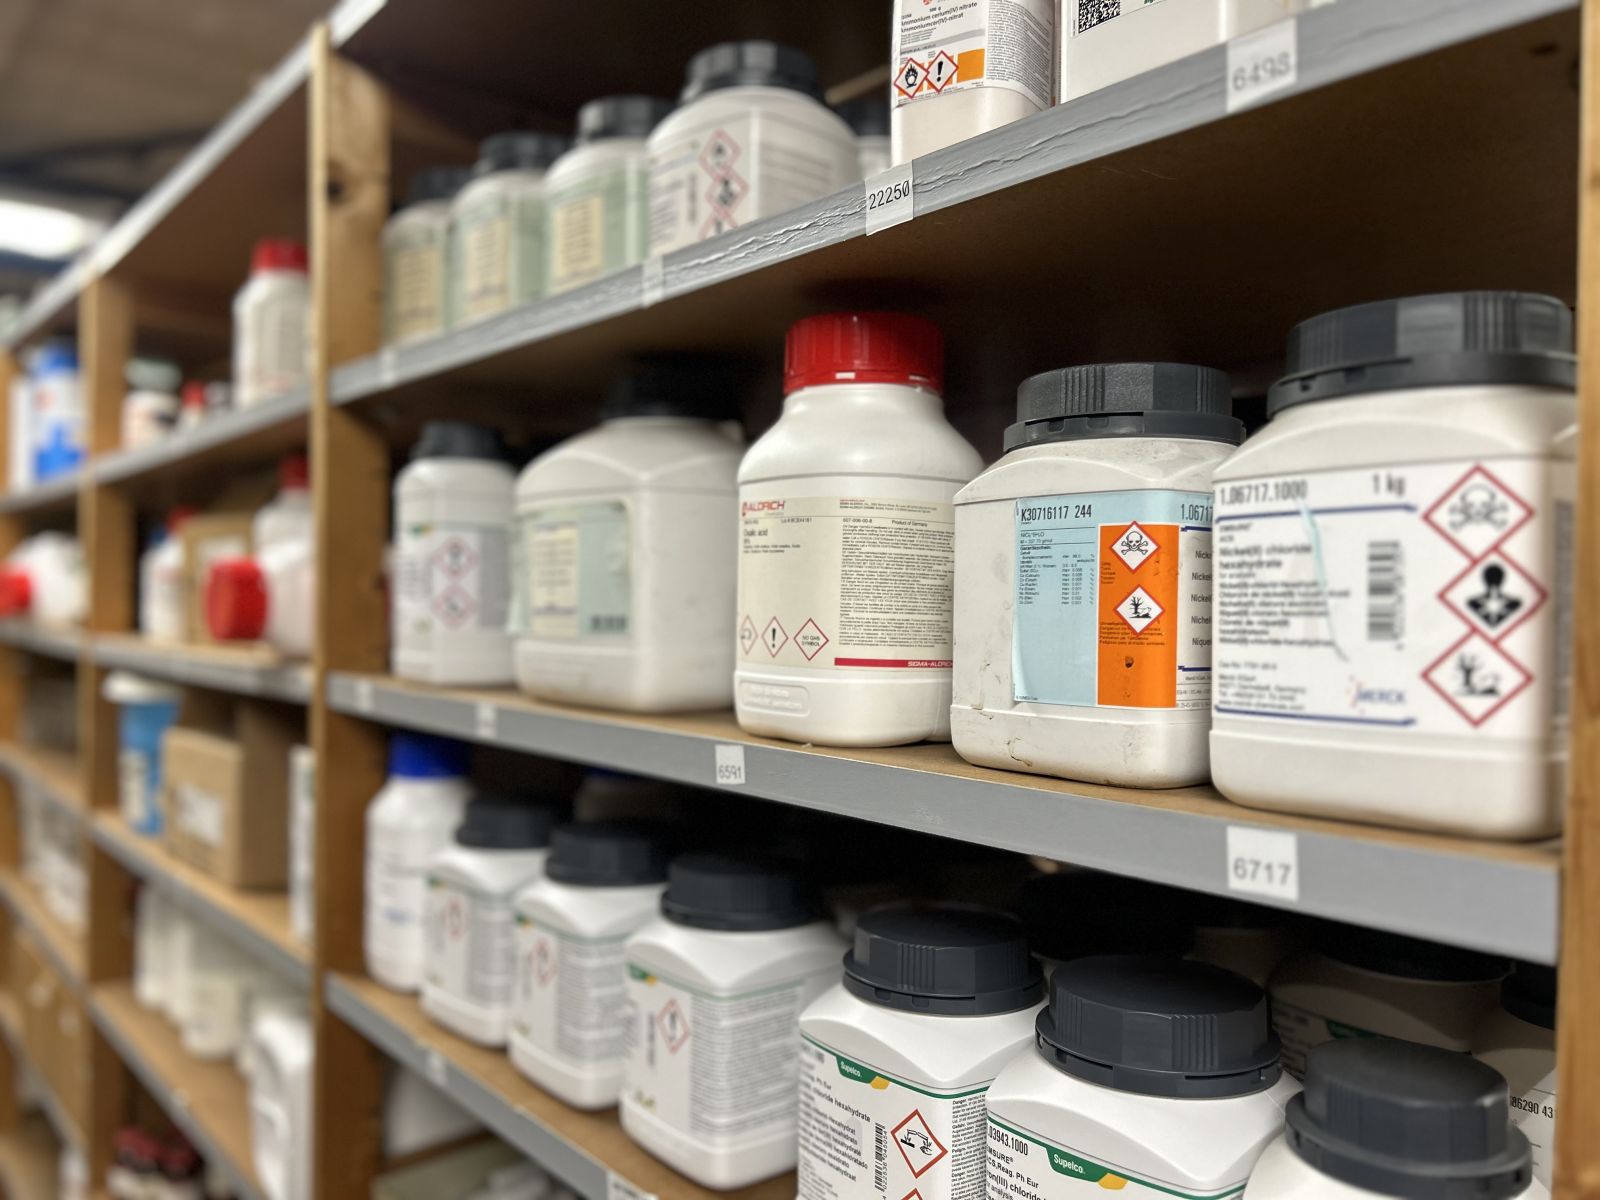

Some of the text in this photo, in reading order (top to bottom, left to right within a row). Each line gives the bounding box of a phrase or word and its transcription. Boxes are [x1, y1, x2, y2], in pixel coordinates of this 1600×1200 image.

[868, 180, 909, 210] 22250
[1021, 504, 1092, 521] K30716117 244
[719, 765, 741, 779] 6591
[1233, 857, 1292, 886] 6717
[834, 1097, 870, 1122] hexahydrate
[1016, 1172, 1024, 1182] Ph
[1026, 1176, 1039, 1188] Eur
